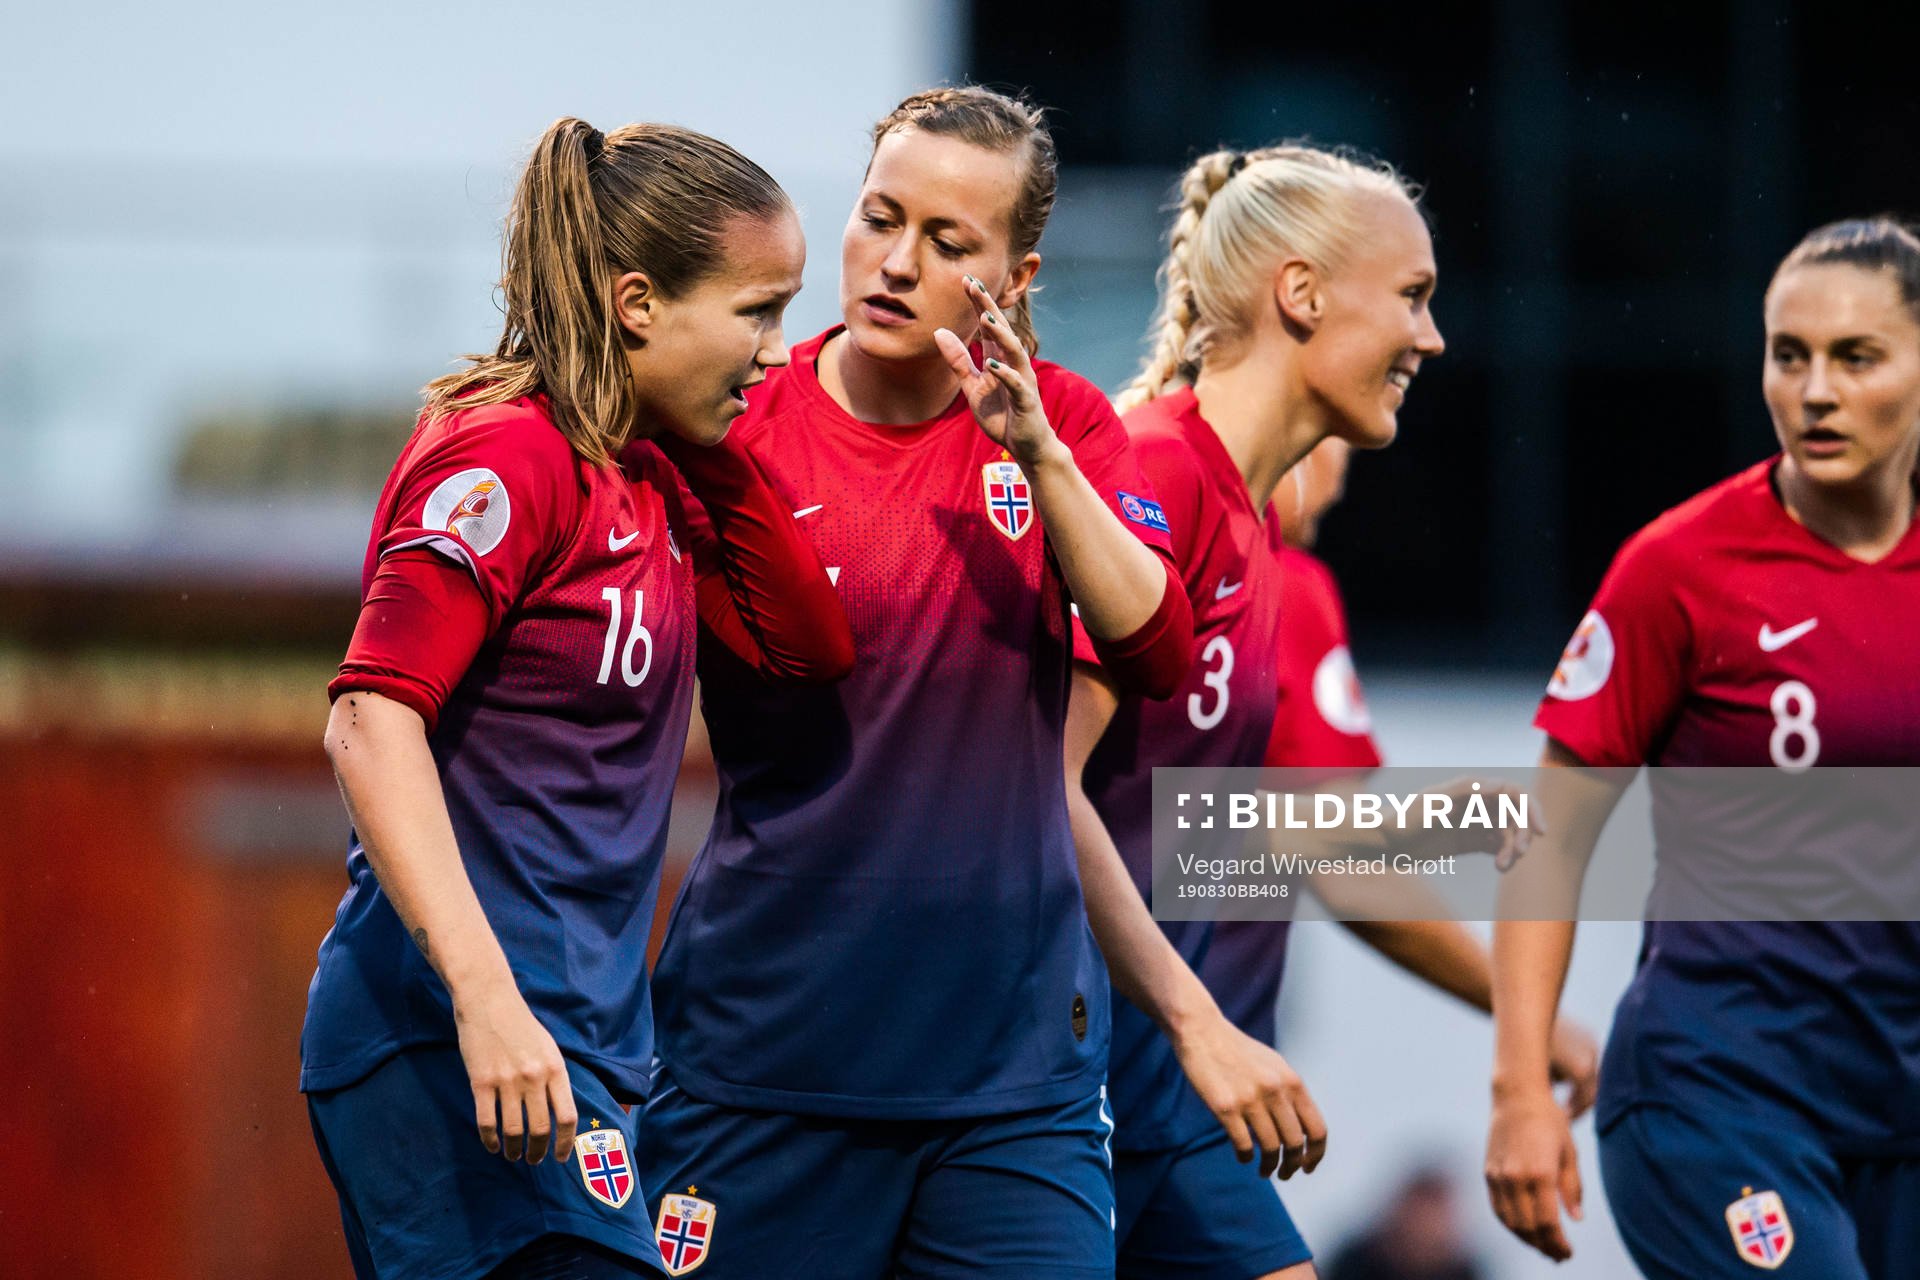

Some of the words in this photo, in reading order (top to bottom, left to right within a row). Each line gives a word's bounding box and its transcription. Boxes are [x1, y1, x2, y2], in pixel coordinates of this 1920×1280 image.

[596, 586, 653, 688] 16
[1187, 635, 1235, 731] 3
[1769, 680, 1821, 774] 8
